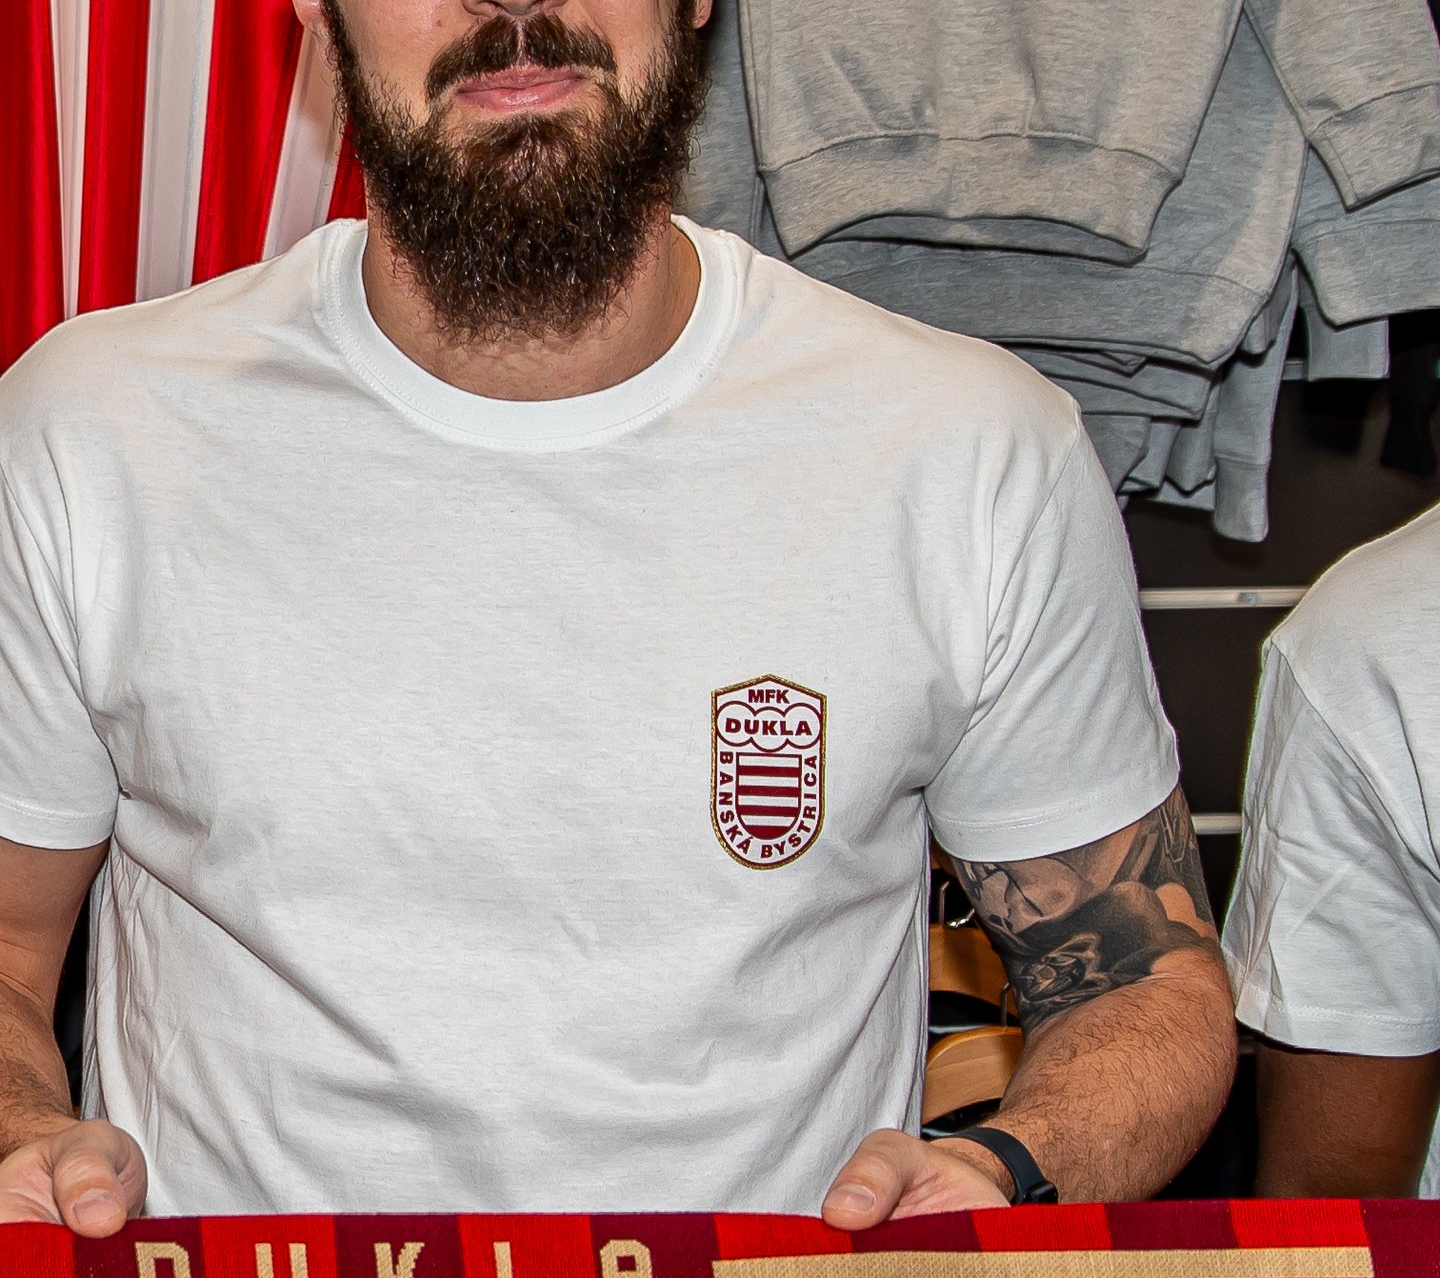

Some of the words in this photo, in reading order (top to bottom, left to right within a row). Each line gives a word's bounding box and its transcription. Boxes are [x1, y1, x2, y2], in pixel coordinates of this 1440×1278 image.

[748, 689, 790, 704] MFK
[725, 717, 813, 737] DUKLA
[719, 751, 754, 855] BANSKÁ
[760, 755, 818, 859] BYSTRICA
